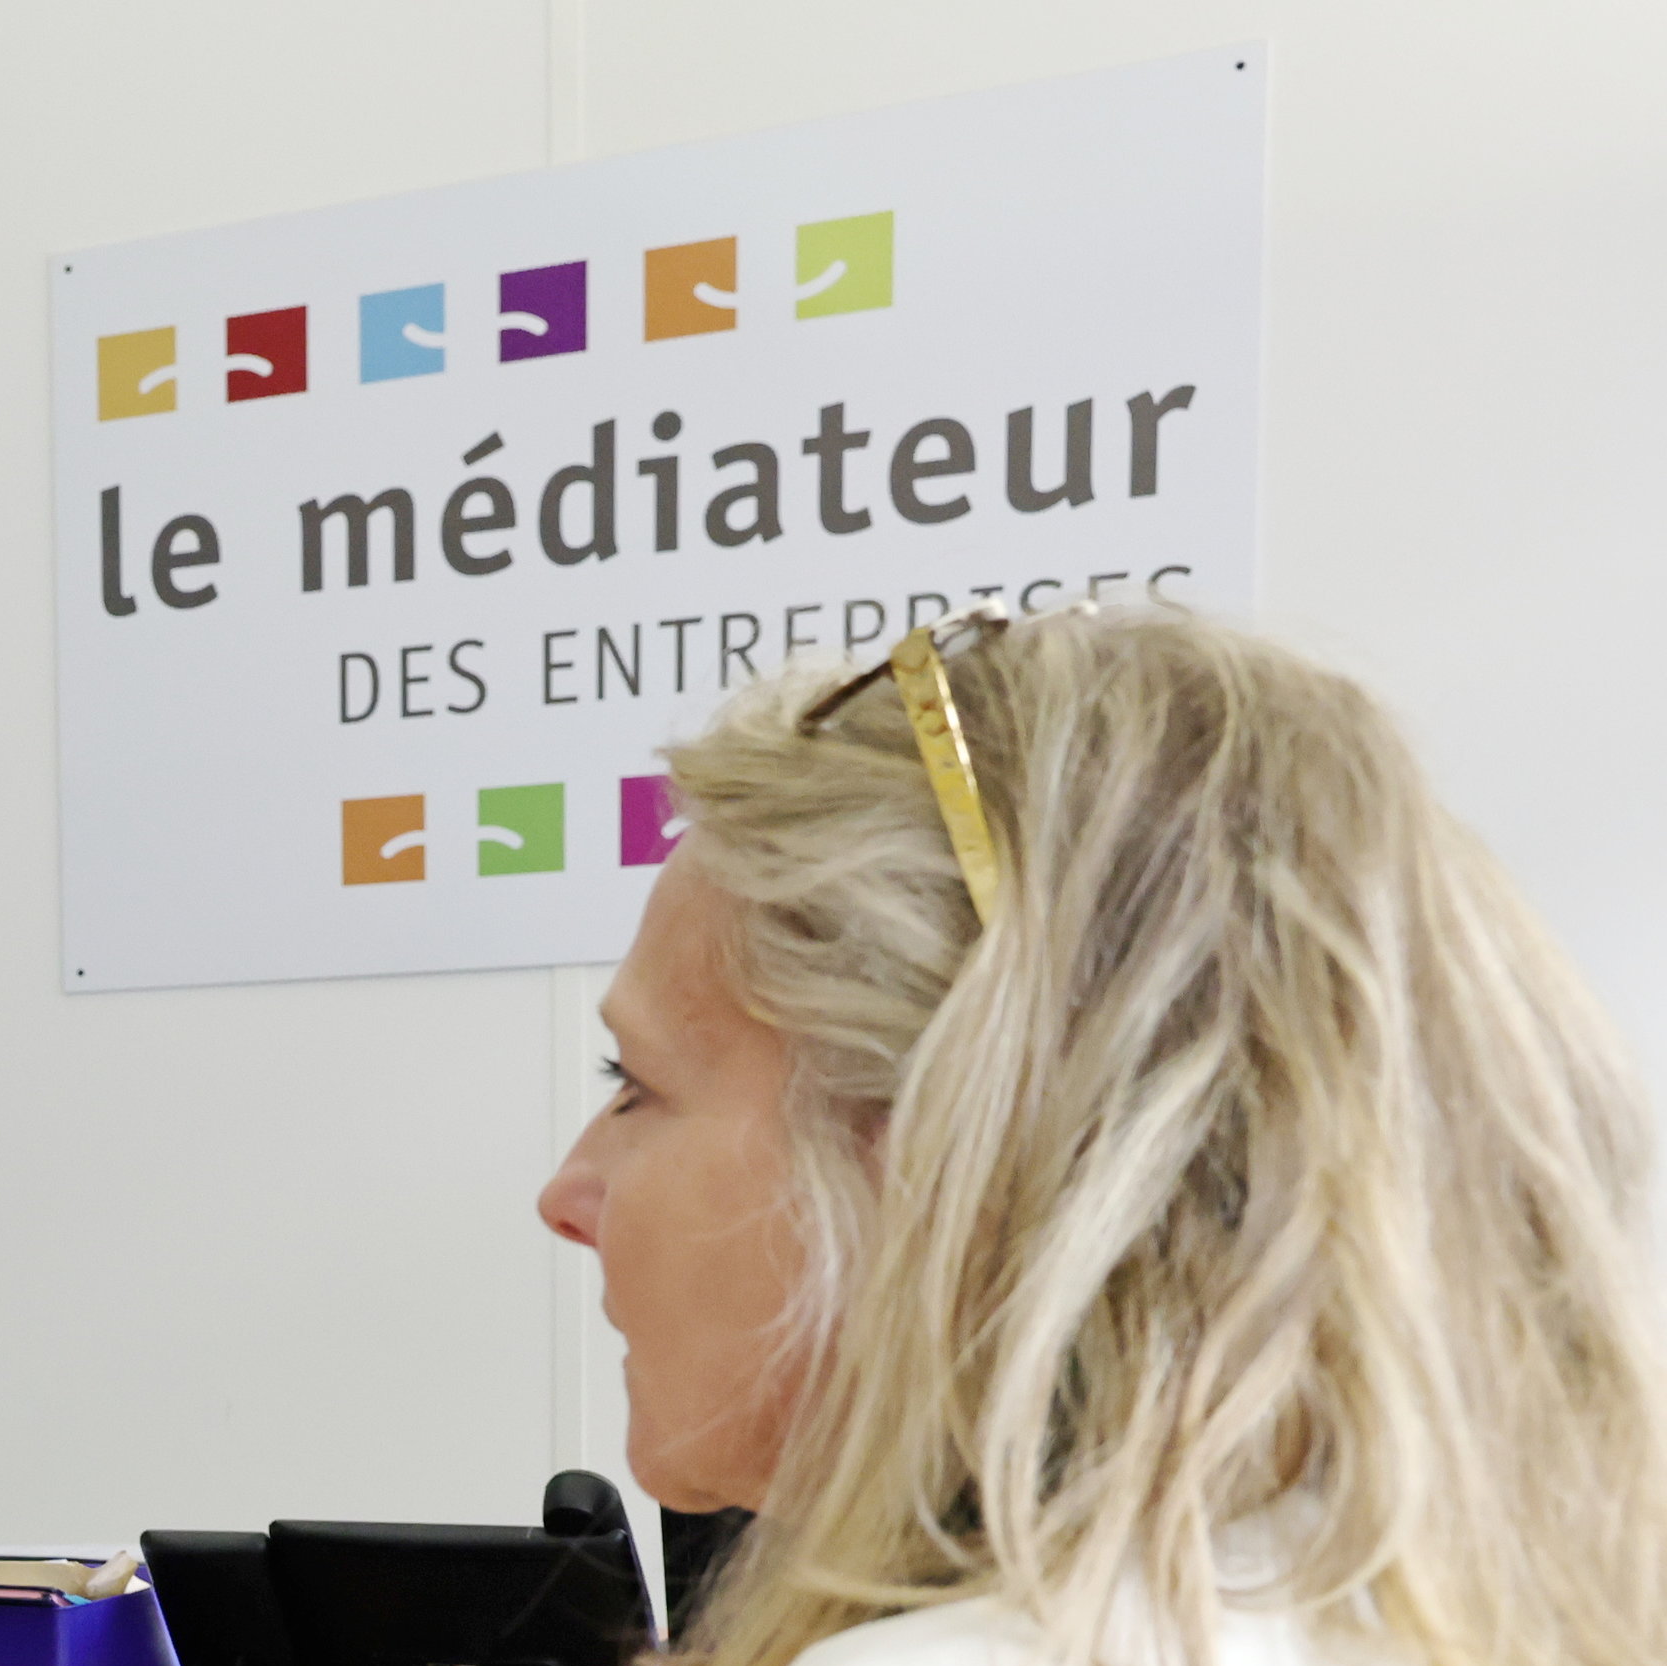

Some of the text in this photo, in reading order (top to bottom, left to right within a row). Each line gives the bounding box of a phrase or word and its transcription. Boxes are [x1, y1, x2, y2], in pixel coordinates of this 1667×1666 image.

[97, 384, 1197, 618] le médiateur
[338, 564, 1193, 725] DES ENTREPS
